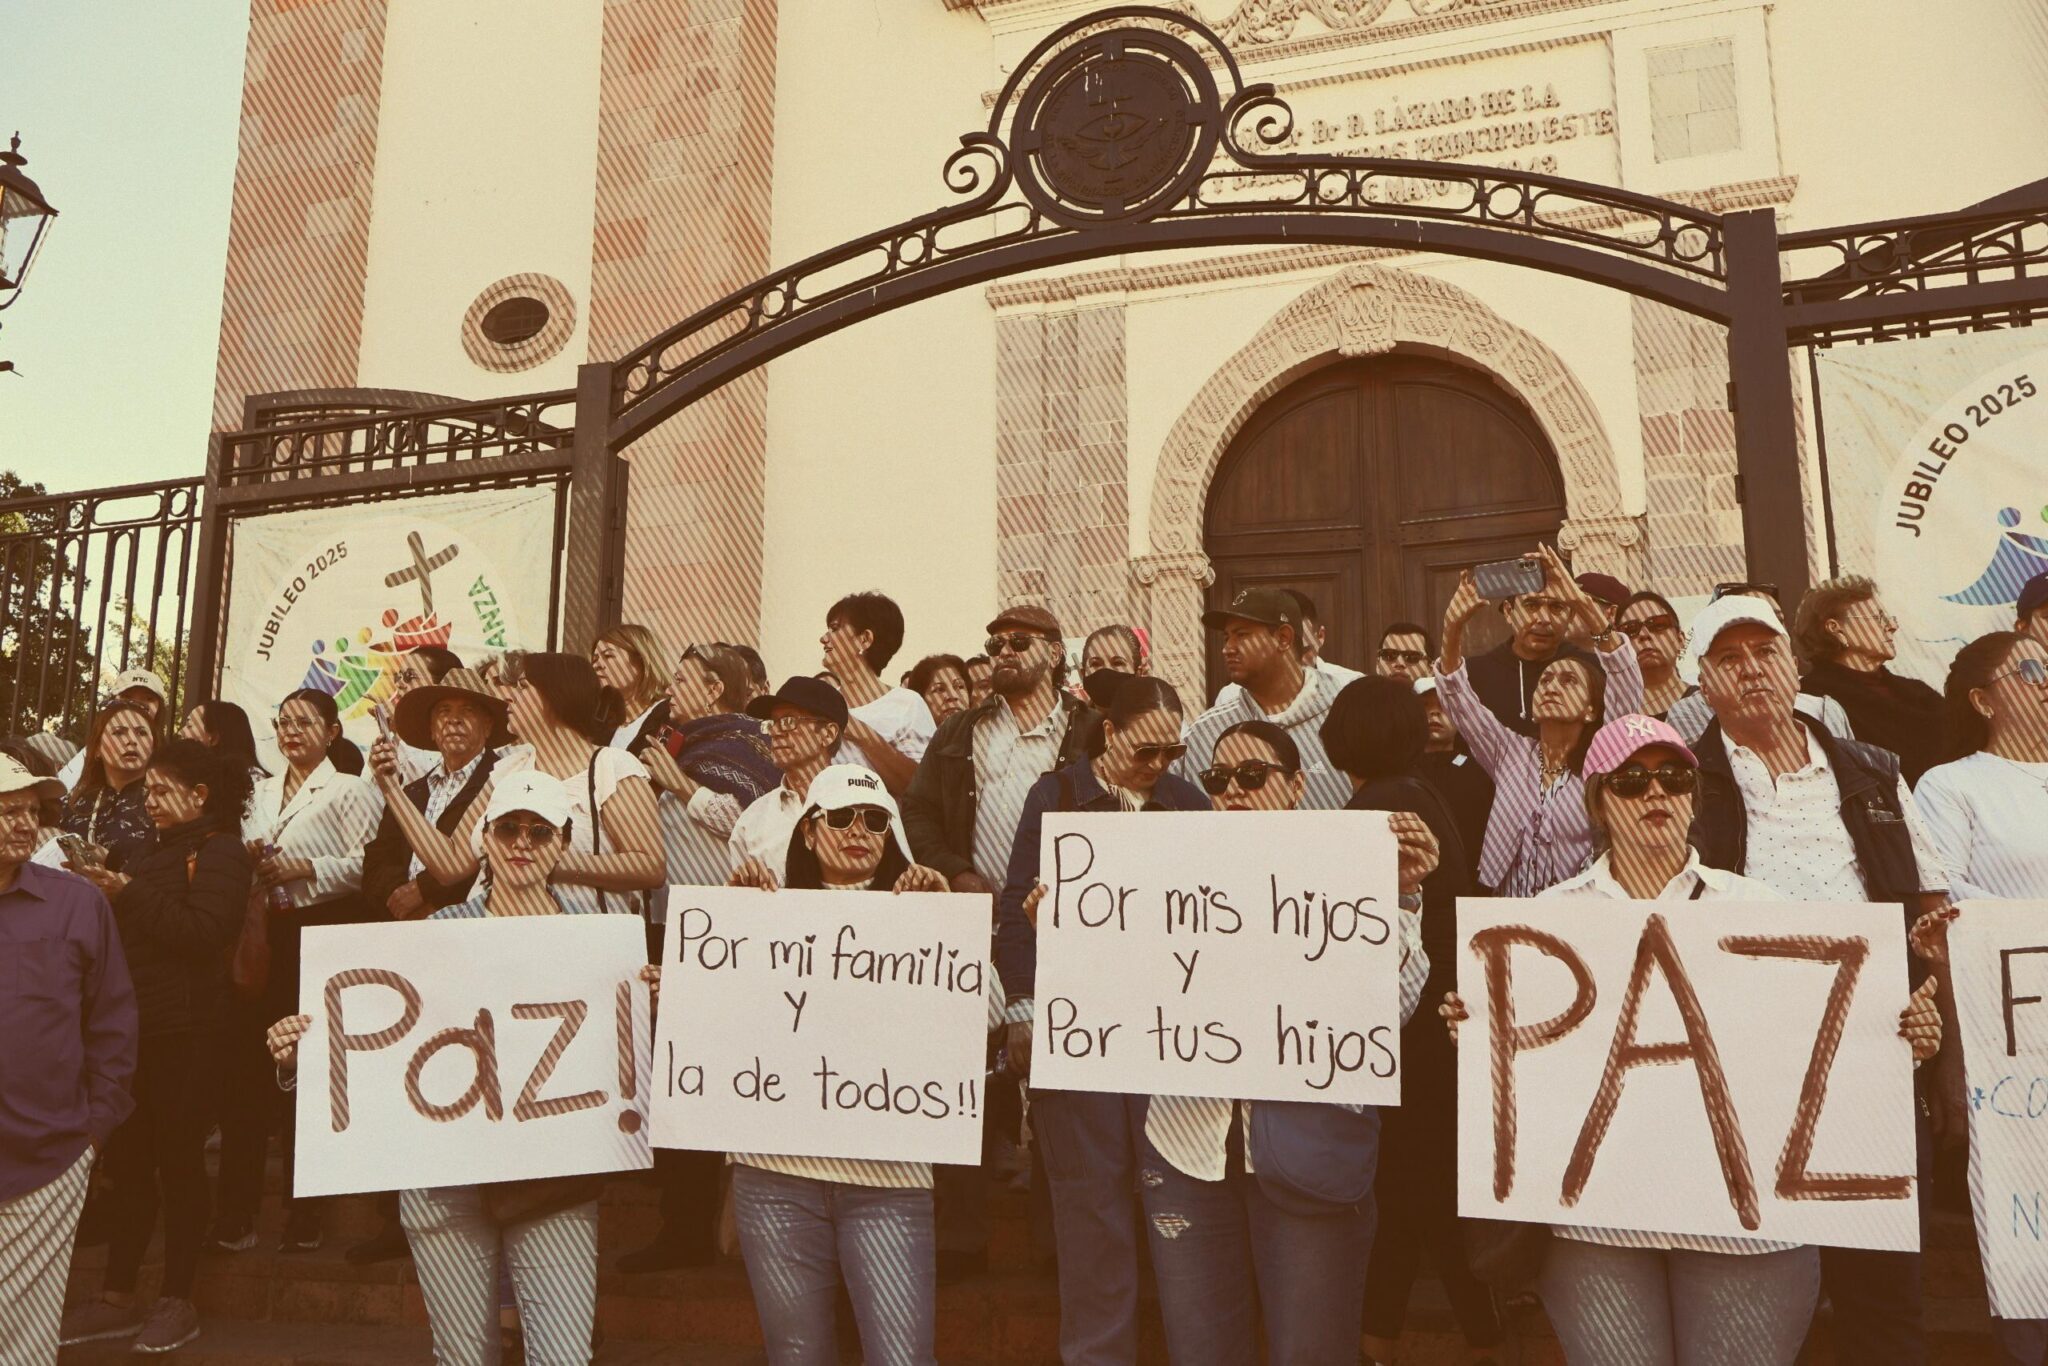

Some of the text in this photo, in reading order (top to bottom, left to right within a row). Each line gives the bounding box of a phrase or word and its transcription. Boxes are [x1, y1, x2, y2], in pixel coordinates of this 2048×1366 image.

[1522, 82, 1561, 111] LA
[1542, 108, 1614, 144] ESTE
[1896, 374, 2037, 538] JUBILEO 2025
[256, 541, 349, 661] JUBILEO 2025
[847, 778, 876, 790] PUMA
[1054, 833, 1390, 962] Por mis hijos
[679, 908, 983, 996] Por mi familia
[324, 967, 642, 1134] Paz!
[669, 1040, 977, 1119] la de todos!!
[1047, 998, 1397, 1090] Por tus hijos
[1469, 913, 1917, 1231] PAZ
